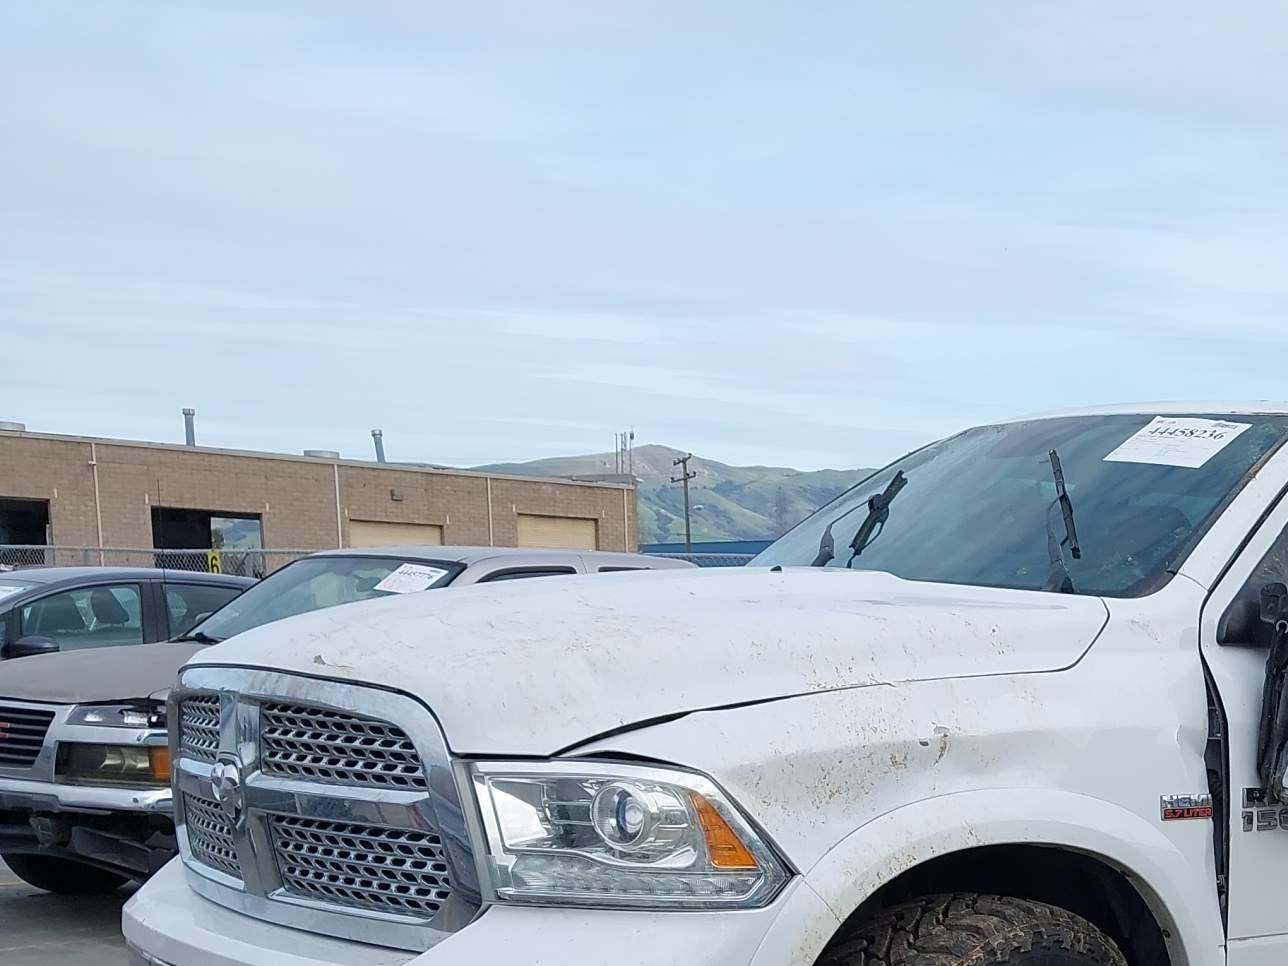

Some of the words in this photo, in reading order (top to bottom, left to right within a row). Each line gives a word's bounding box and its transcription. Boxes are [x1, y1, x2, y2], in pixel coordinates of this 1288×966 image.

[1148, 426, 1225, 440] 44458236
[1160, 794, 1212, 808] HEMI
[1165, 808, 1183, 818] 5.7
[1184, 807, 1212, 818] LITER
